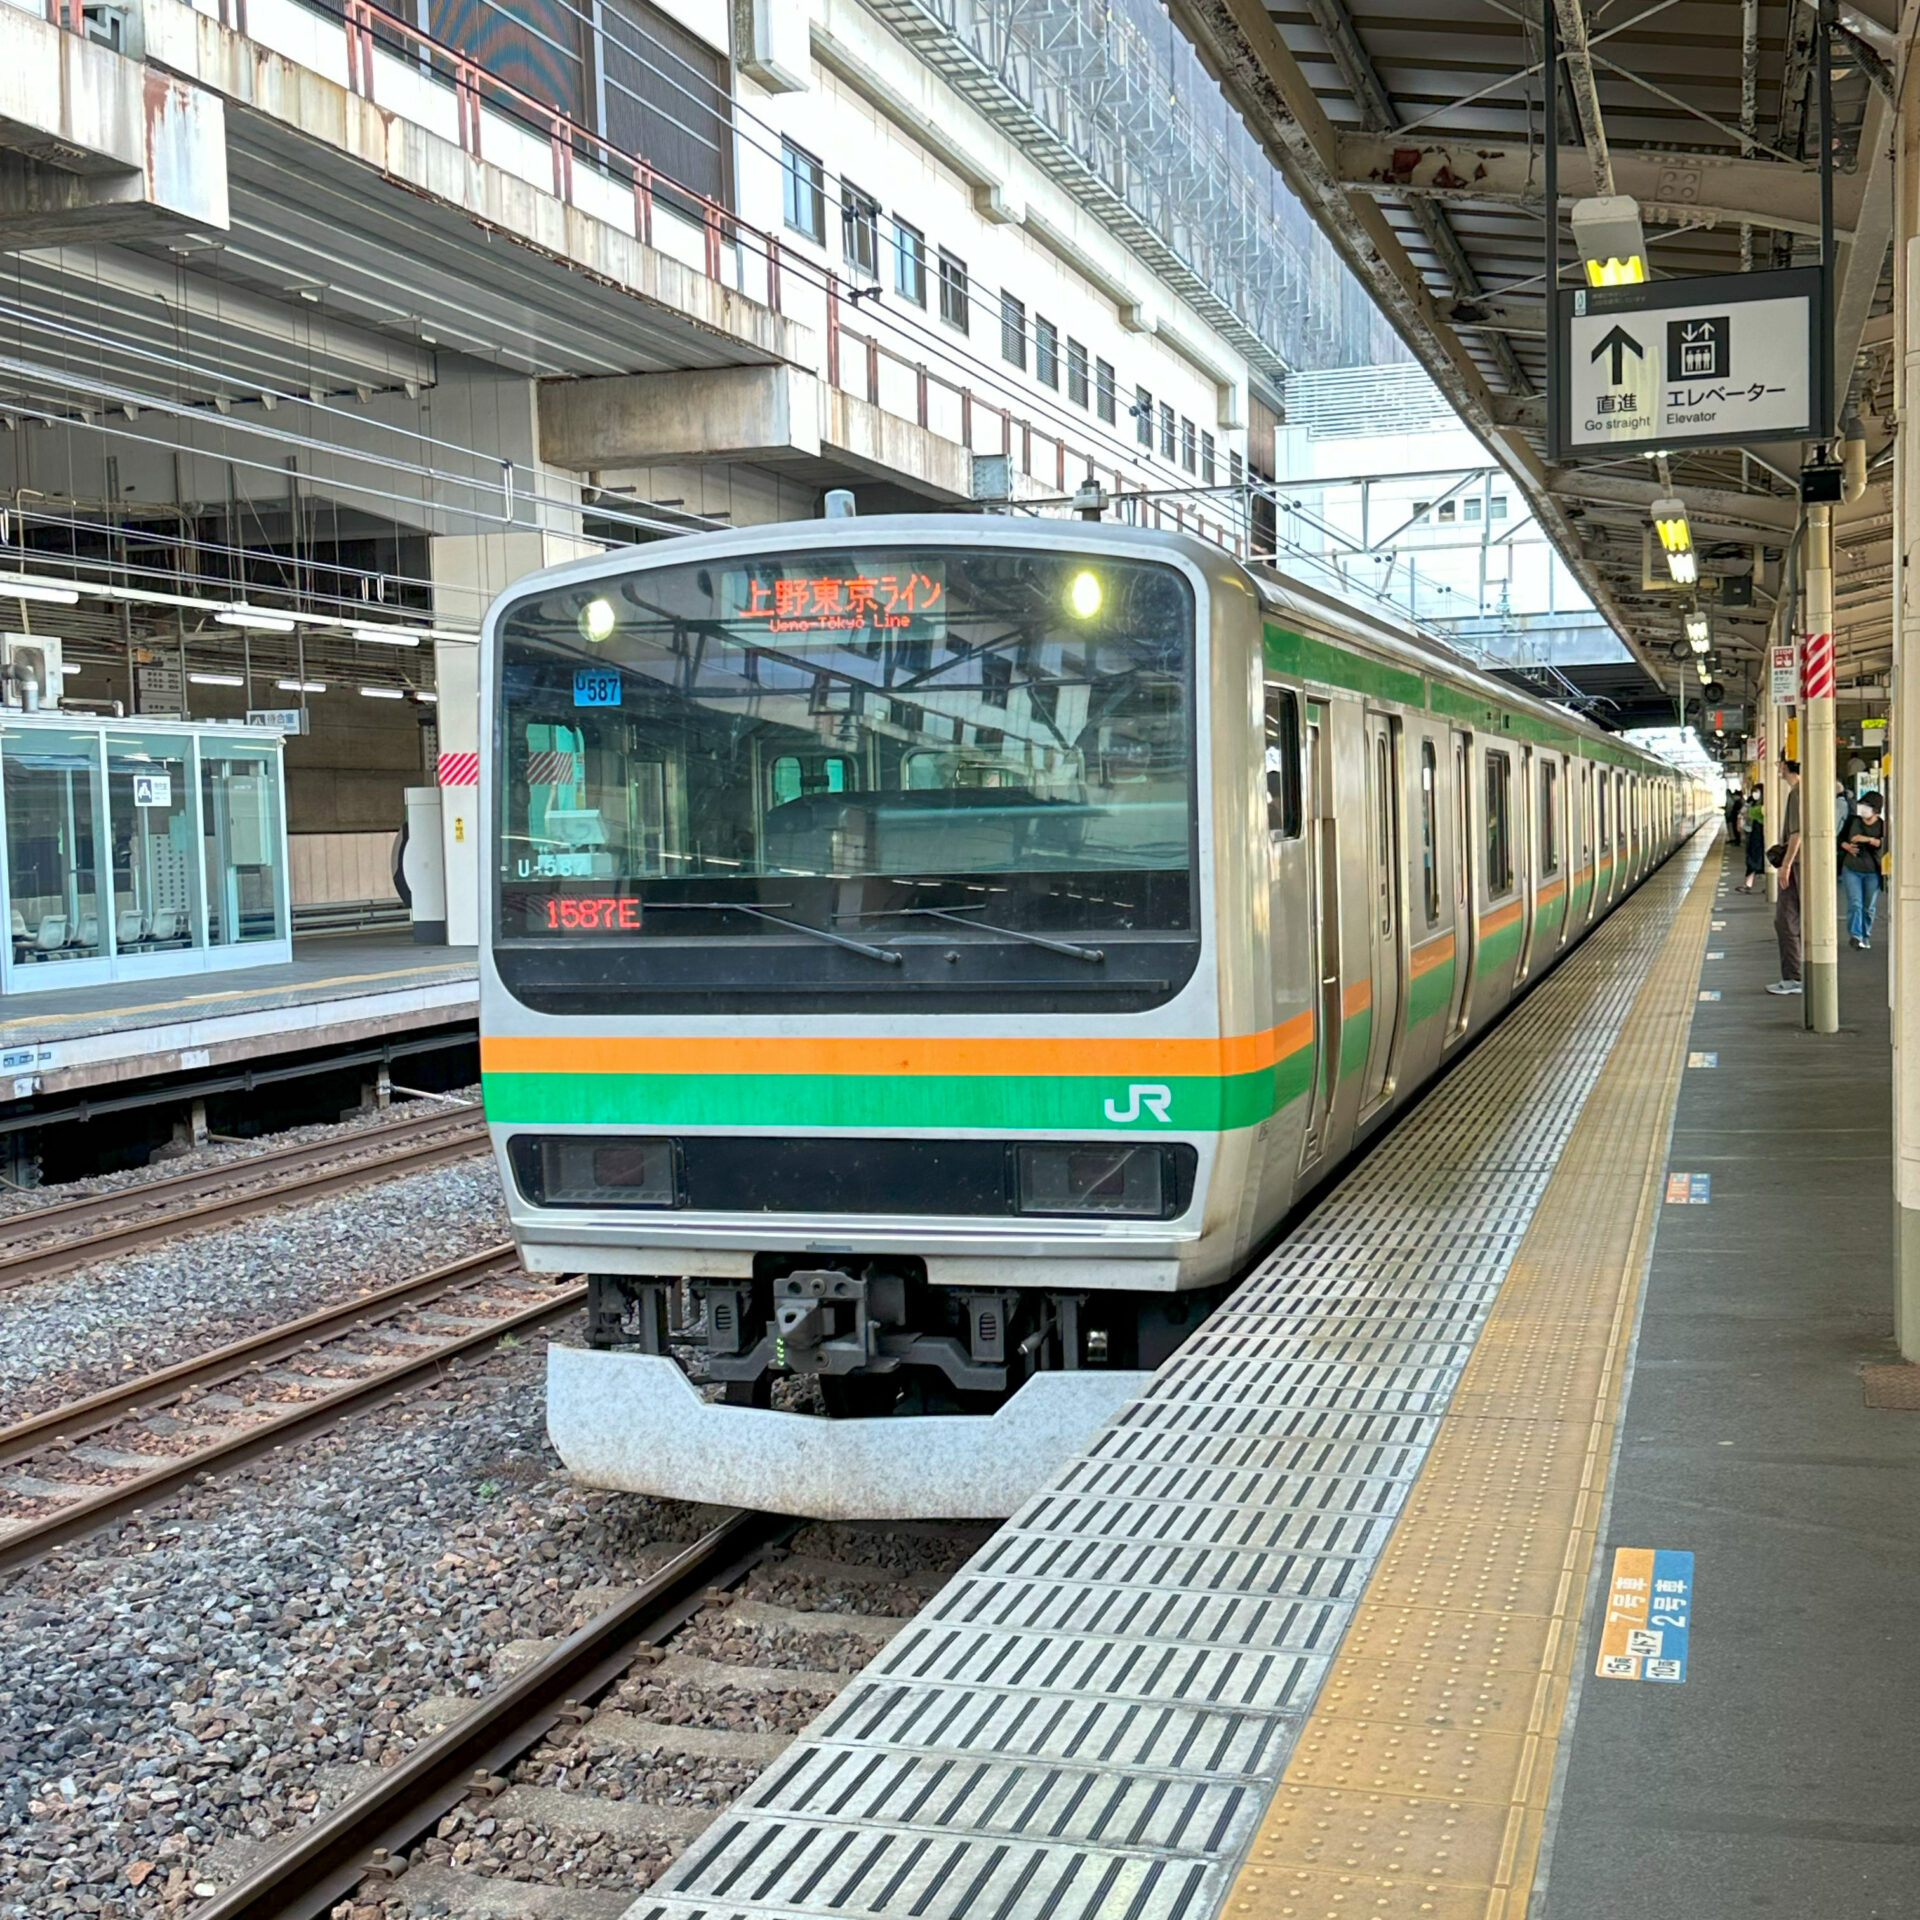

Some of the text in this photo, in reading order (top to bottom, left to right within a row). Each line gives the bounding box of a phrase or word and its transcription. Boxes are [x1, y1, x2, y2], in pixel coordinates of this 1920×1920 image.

[1596, 393, 1638, 415] 直進
[1666, 383, 1786, 409] エレベーター
[1585, 415, 1651, 431] Go straight
[1666, 411, 1717, 425] Elevator
[738, 574, 942, 618] 上野東京ライン
[873, 613, 911, 628] Line
[547, 897, 641, 929] 1587E
[1104, 1084, 1173, 1123] JR
[1610, 1577, 1647, 1622] 7号車
[1651, 1579, 1688, 1628] 2号車
[1631, 1631, 1657, 1655] 4ドア
